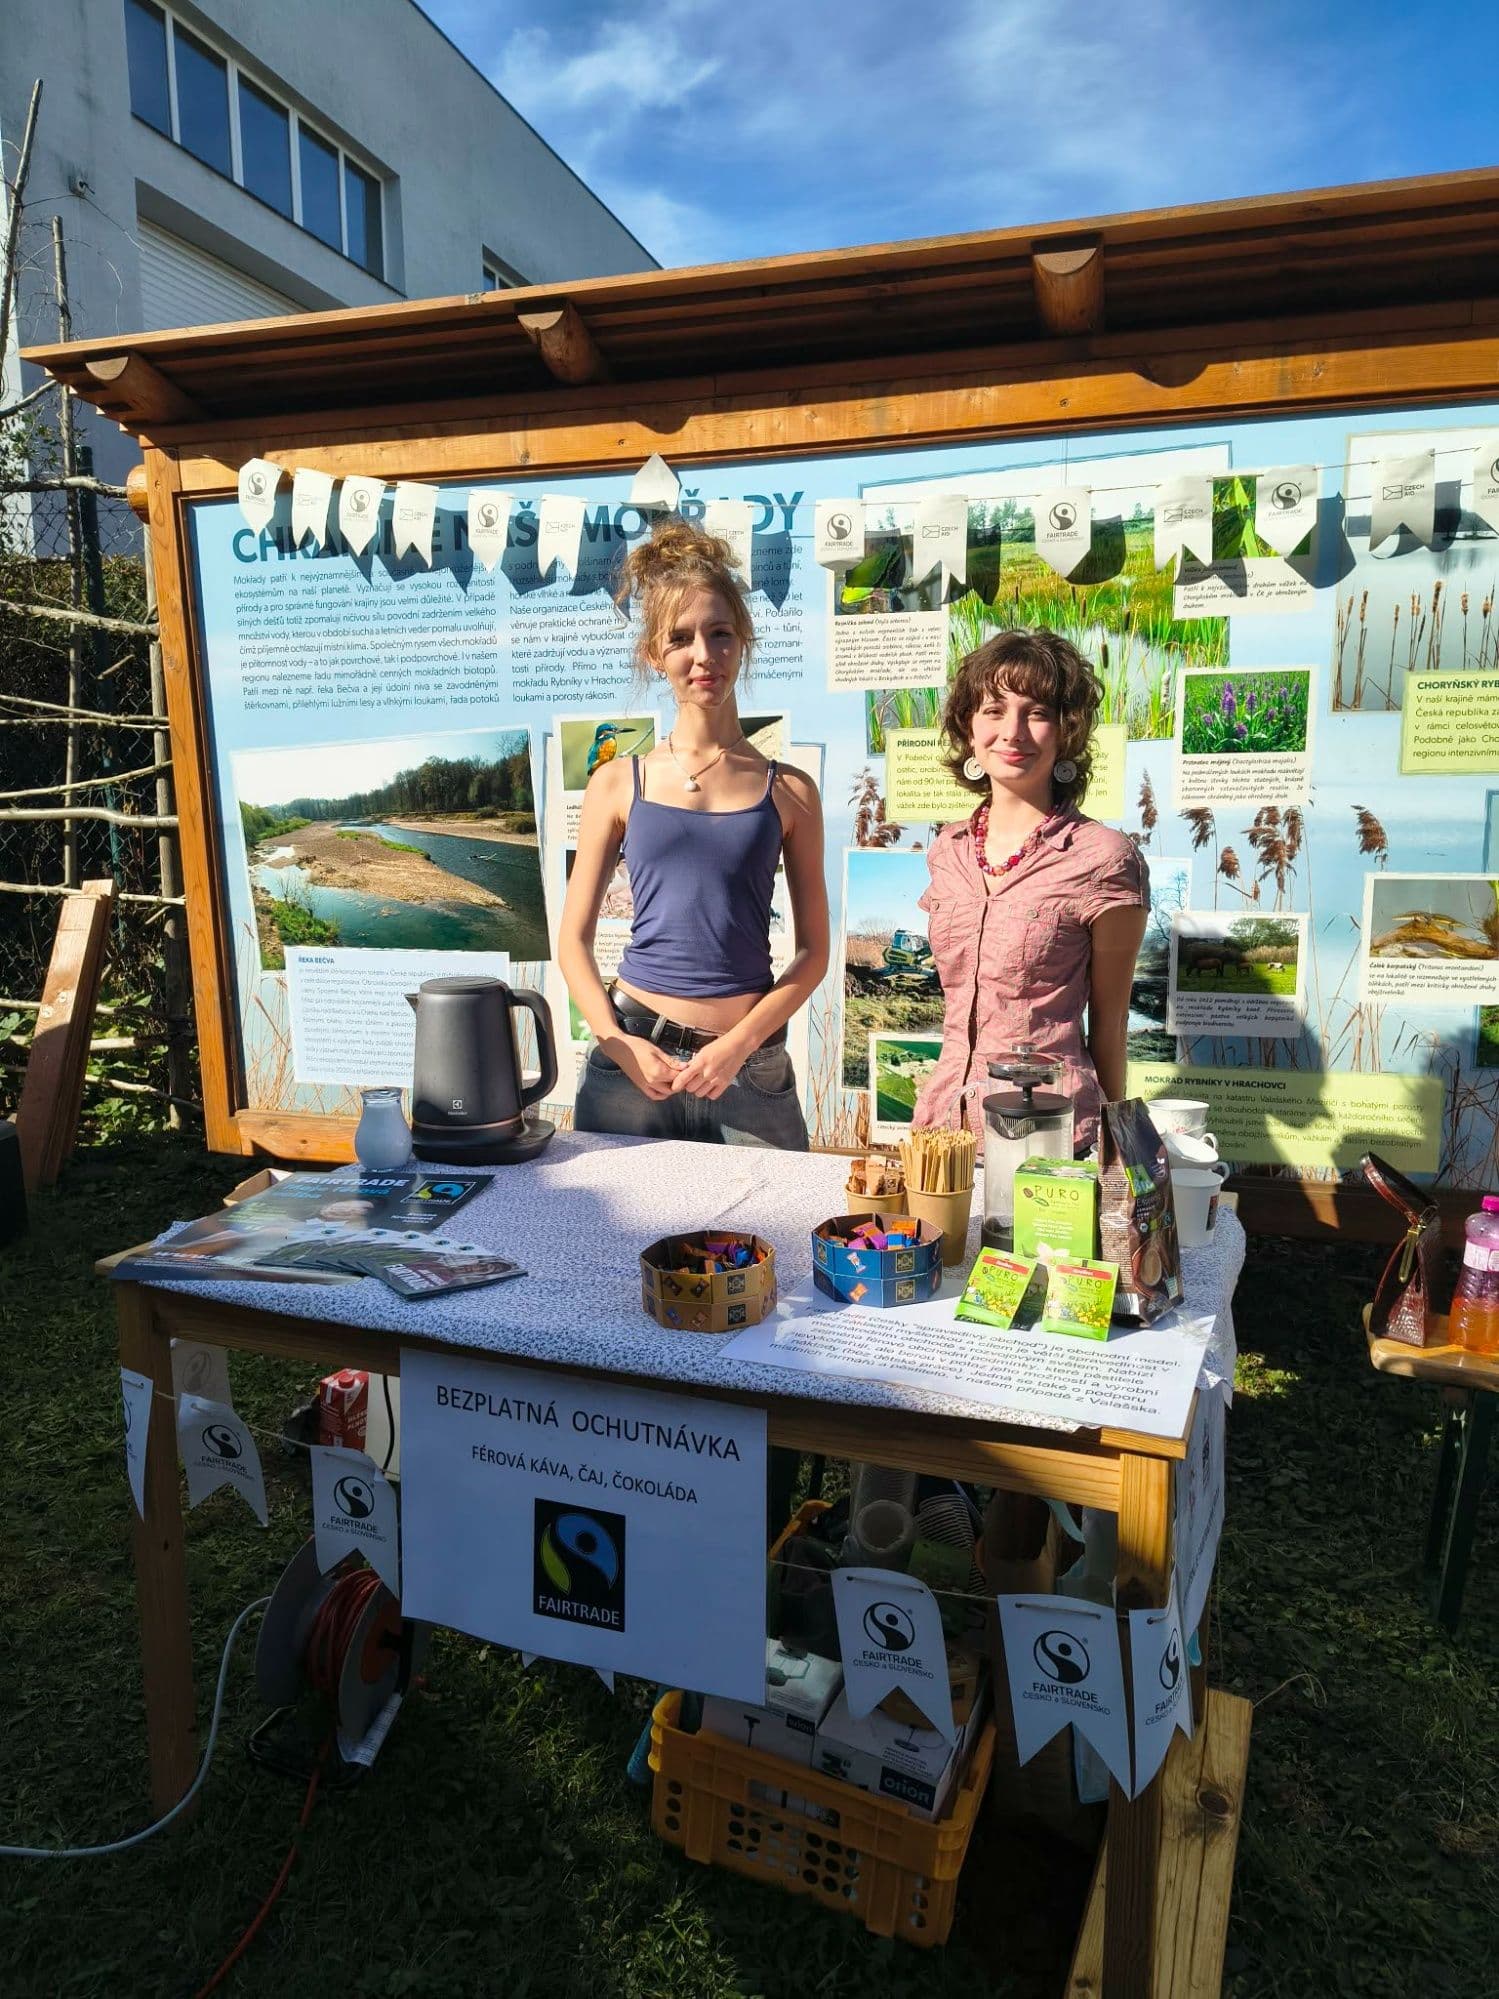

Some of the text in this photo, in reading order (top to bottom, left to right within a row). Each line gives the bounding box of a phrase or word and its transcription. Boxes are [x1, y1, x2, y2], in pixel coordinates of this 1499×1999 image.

[1046, 531, 1079, 539] FAIRTRADE
[1417, 679, 1479, 689] CHORYŇSKÝ
[1416, 695, 1423, 703] V
[1445, 695, 1474, 704] krajině
[1415, 707, 1443, 717] Česká
[1445, 708, 1489, 717] republika
[1427, 722, 1450, 730] rámci
[897, 738, 936, 748] PŘÍRODNÍ
[1413, 736, 1454, 744] Podobně
[1458, 735, 1477, 745] jako
[1413, 749, 1446, 759] regionu
[1185, 1078, 1222, 1087] RYBNÍKY
[1232, 1080, 1286, 1090] HRACHOVCI
[296, 1176, 411, 1187] FAIRTRADE
[1034, 1185, 1079, 1201] PURO
[989, 1266, 1019, 1282] PURO
[437, 1385, 740, 1462] BEZPLATNÁ OCHUTNÁVKA
[201, 1455, 248, 1474] FAIRTRADE
[472, 1445, 698, 1504] FÉROVÁ KÁVA, ČAJ, ČOKOLÁDA
[330, 1517, 378, 1533] FAIRTRADE
[538, 1595, 620, 1626] FAIRTRADE
[862, 1650, 923, 1669] FAIRTRADE
[888, 1663, 934, 1680] SLOVENSKO
[1032, 1682, 1098, 1703] FAIRTRADE
[1023, 1690, 1052, 1702] ČESKO
[1061, 1696, 1111, 1716] SLOVENSKO
